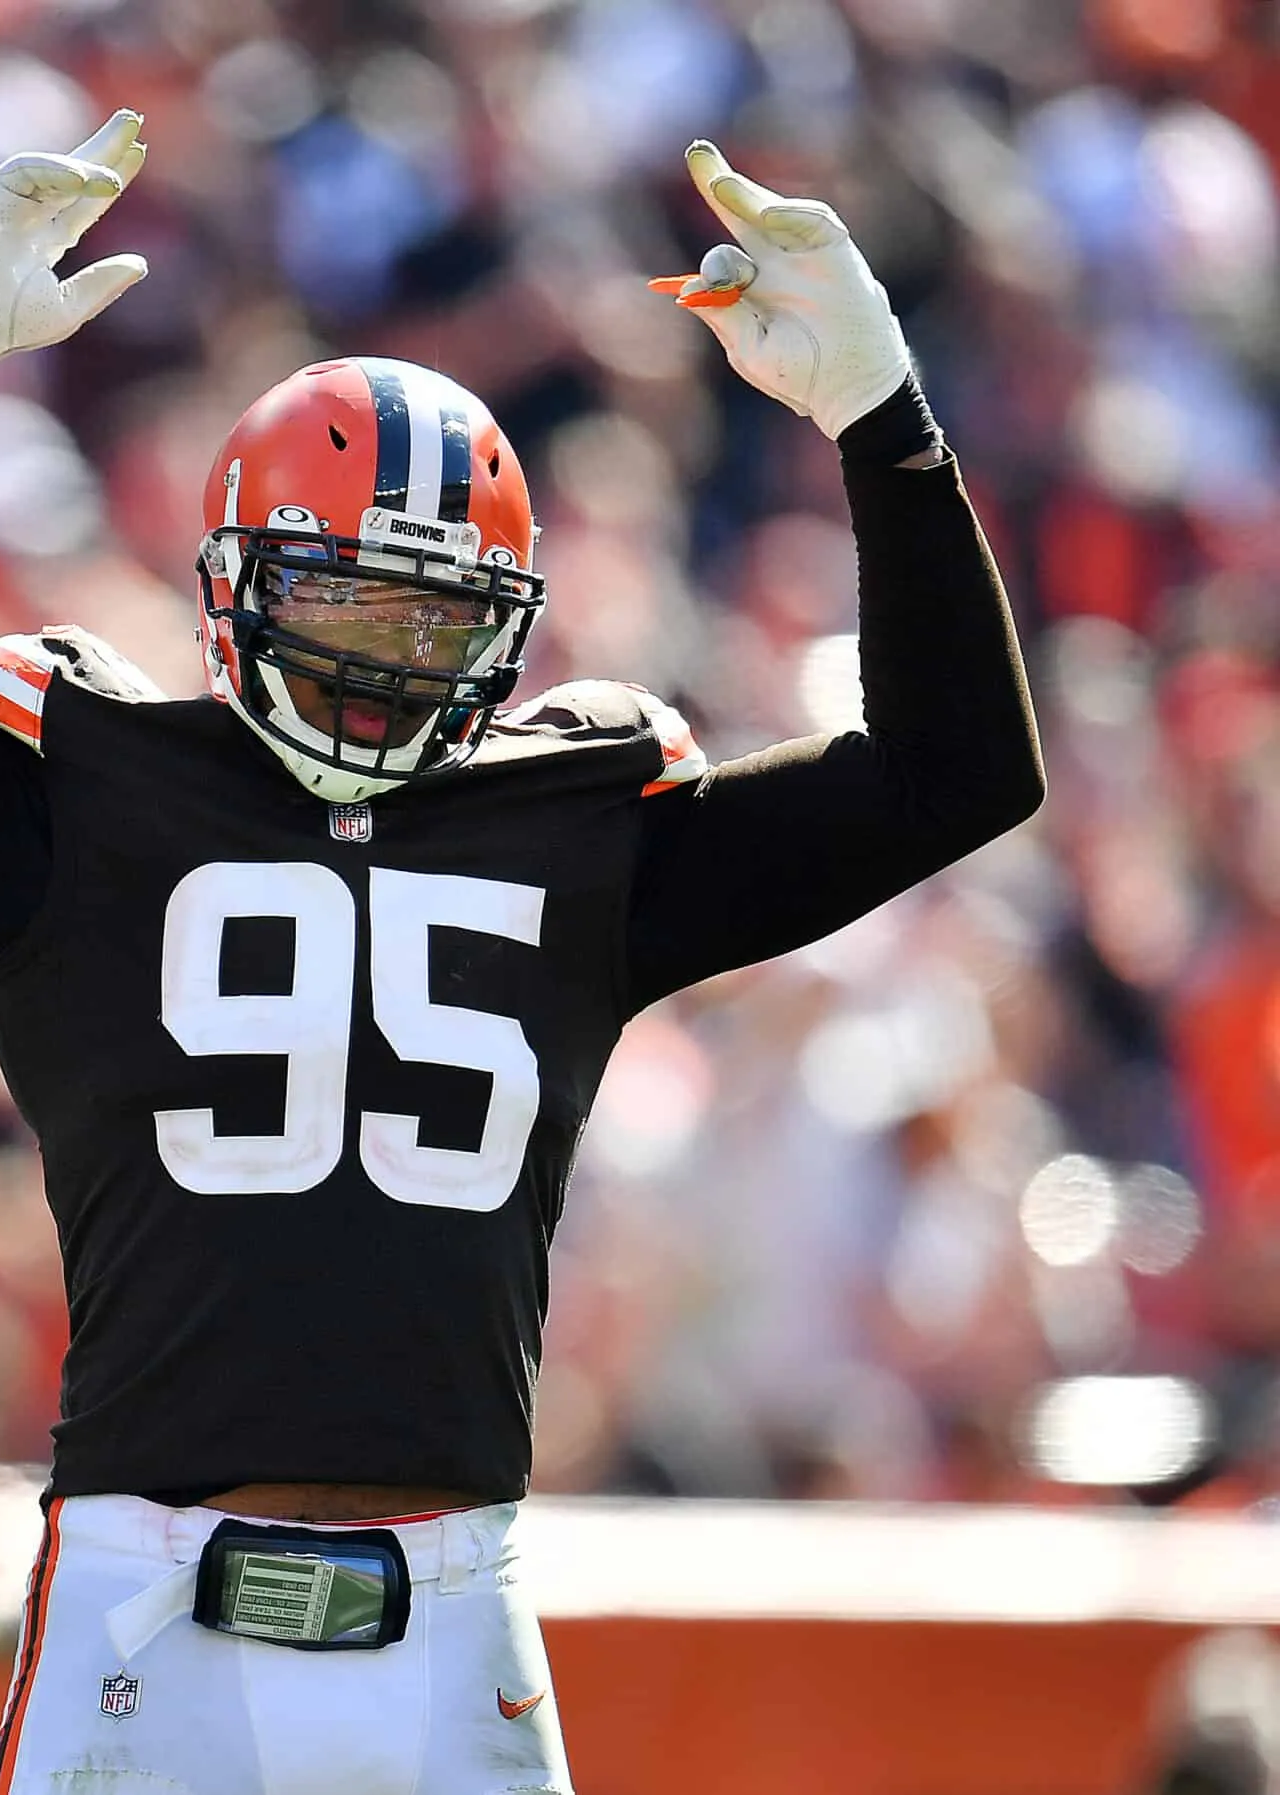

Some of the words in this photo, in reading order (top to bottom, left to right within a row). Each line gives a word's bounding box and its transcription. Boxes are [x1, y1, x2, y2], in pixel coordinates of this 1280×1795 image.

[389, 518, 446, 543] BROWNS
[336, 817, 365, 837] NFL
[152, 861, 547, 1213] 95
[104, 1692, 132, 1713] NFL
